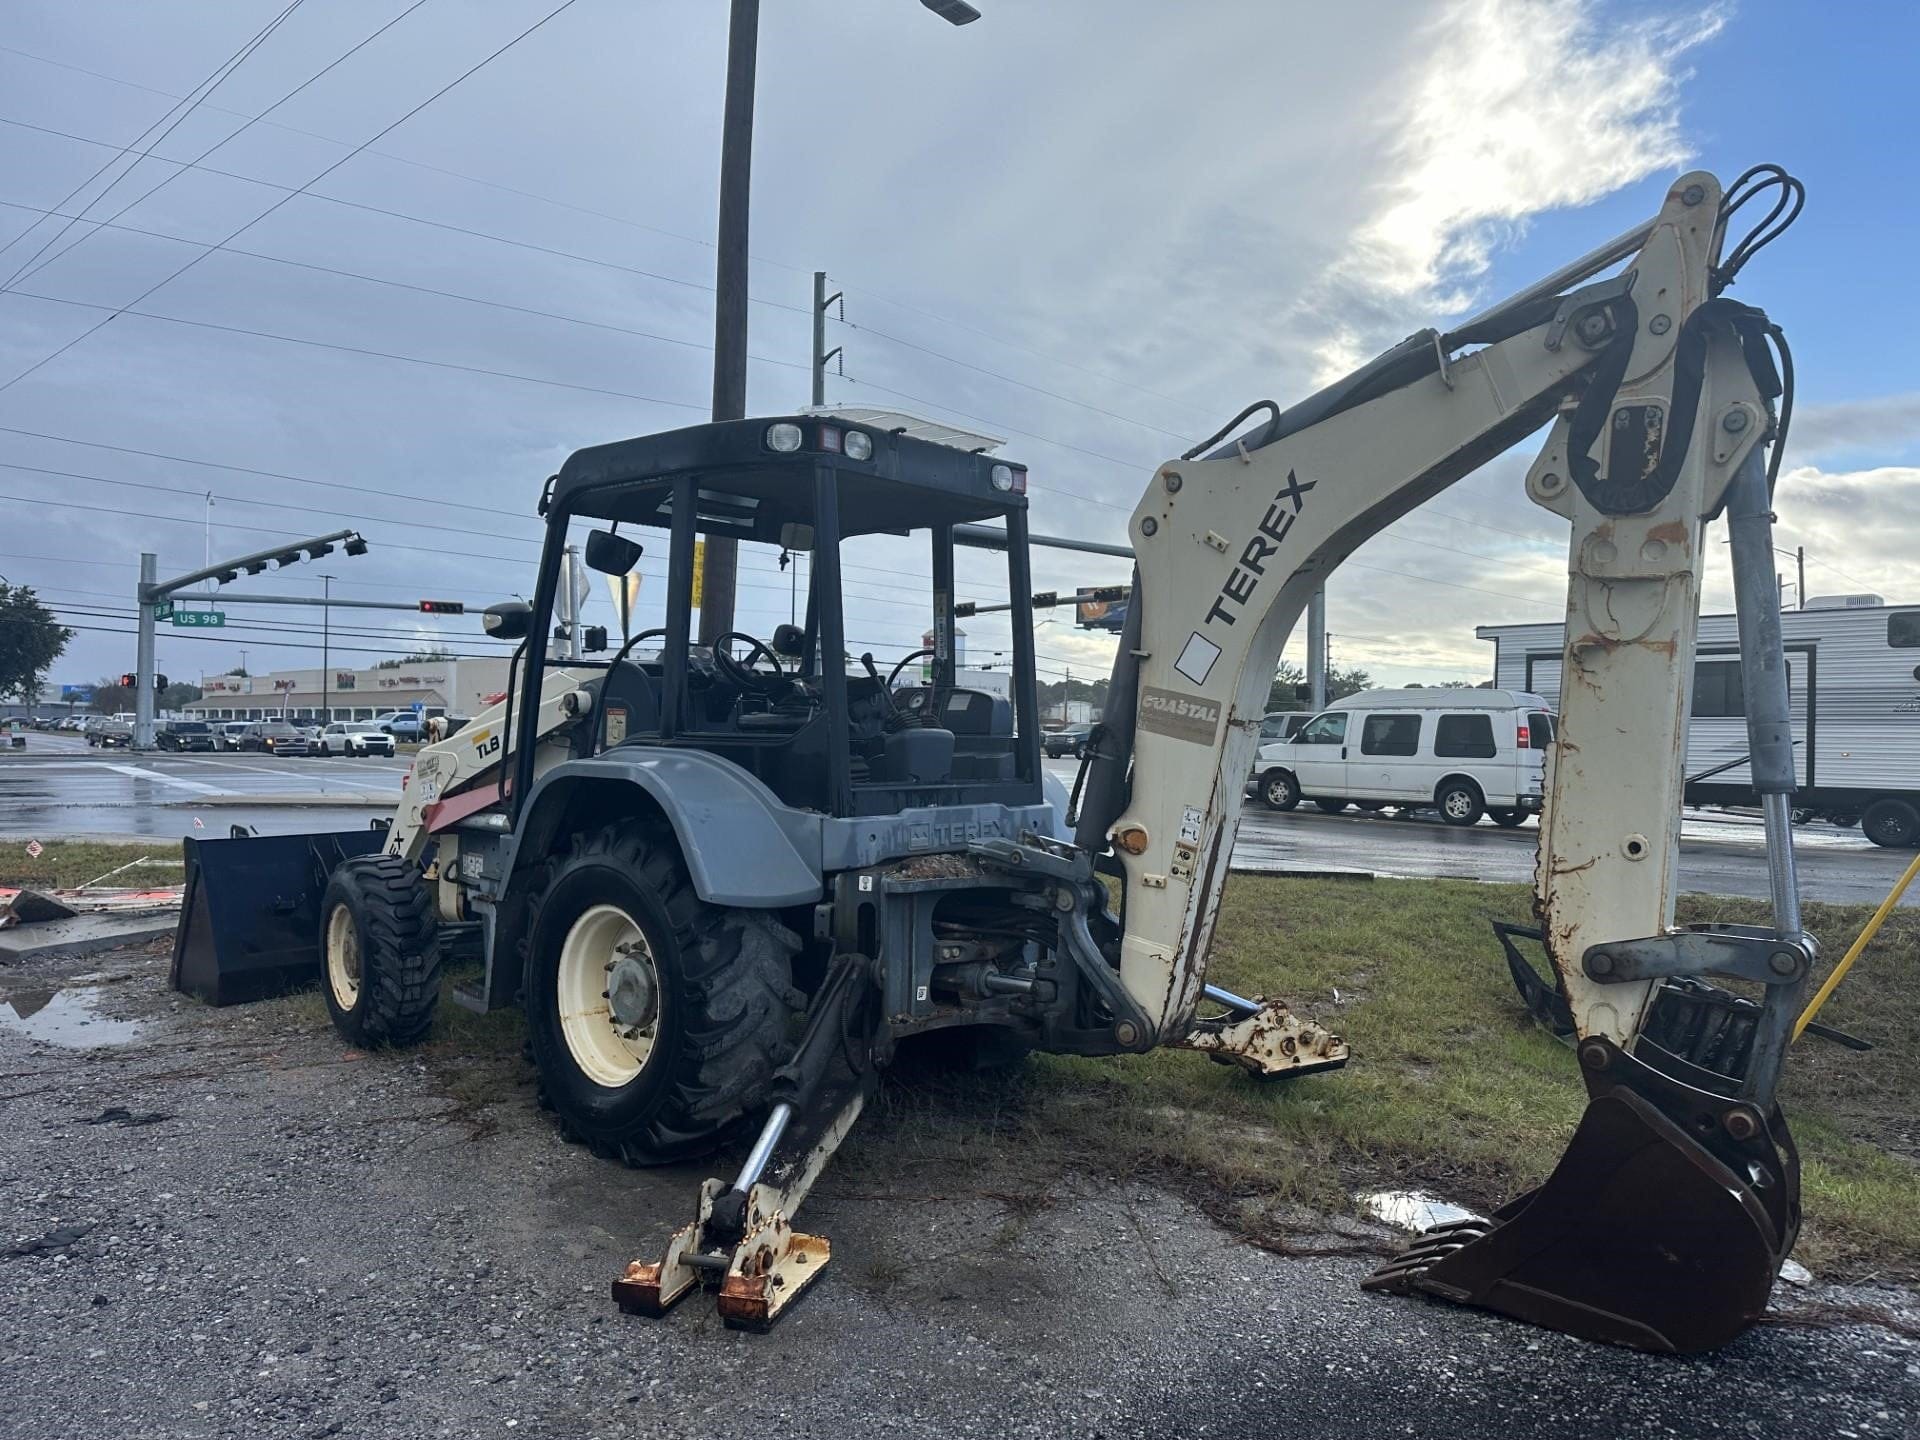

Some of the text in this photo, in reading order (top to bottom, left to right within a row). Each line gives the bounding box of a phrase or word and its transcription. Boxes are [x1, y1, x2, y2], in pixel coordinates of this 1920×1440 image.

[1205, 467, 1318, 626] TEREX
[180, 614, 218, 624] US 98
[1142, 695, 1217, 722] COASTAL
